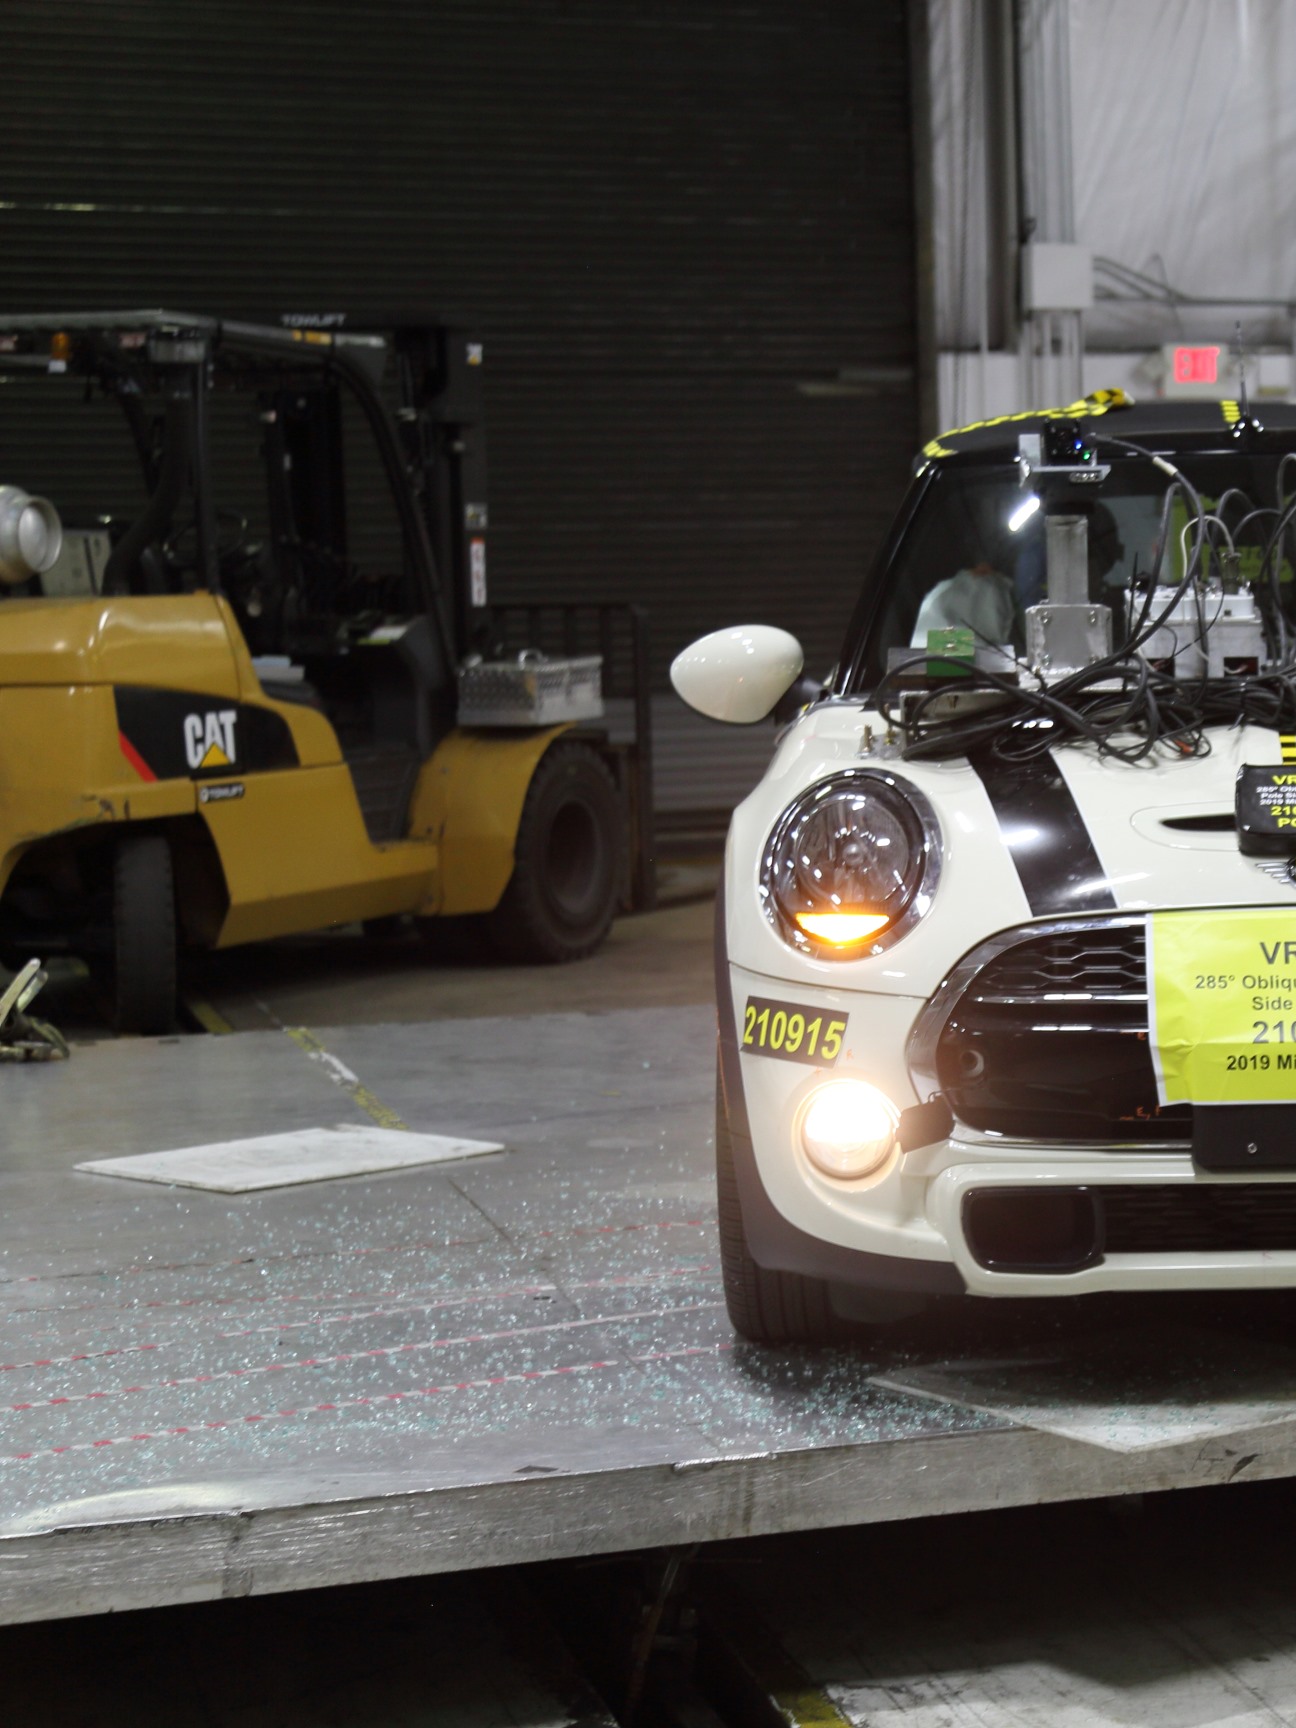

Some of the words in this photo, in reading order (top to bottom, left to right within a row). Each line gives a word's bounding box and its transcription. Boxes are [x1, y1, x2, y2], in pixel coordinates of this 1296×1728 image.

[1173, 346, 1220, 384] EXIT
[184, 709, 237, 769] CAT
[1195, 975, 1235, 989] 285°
[1252, 996, 1293, 1010] Side
[743, 1005, 846, 1060] 210915
[1226, 1055, 1270, 1070] 2019
